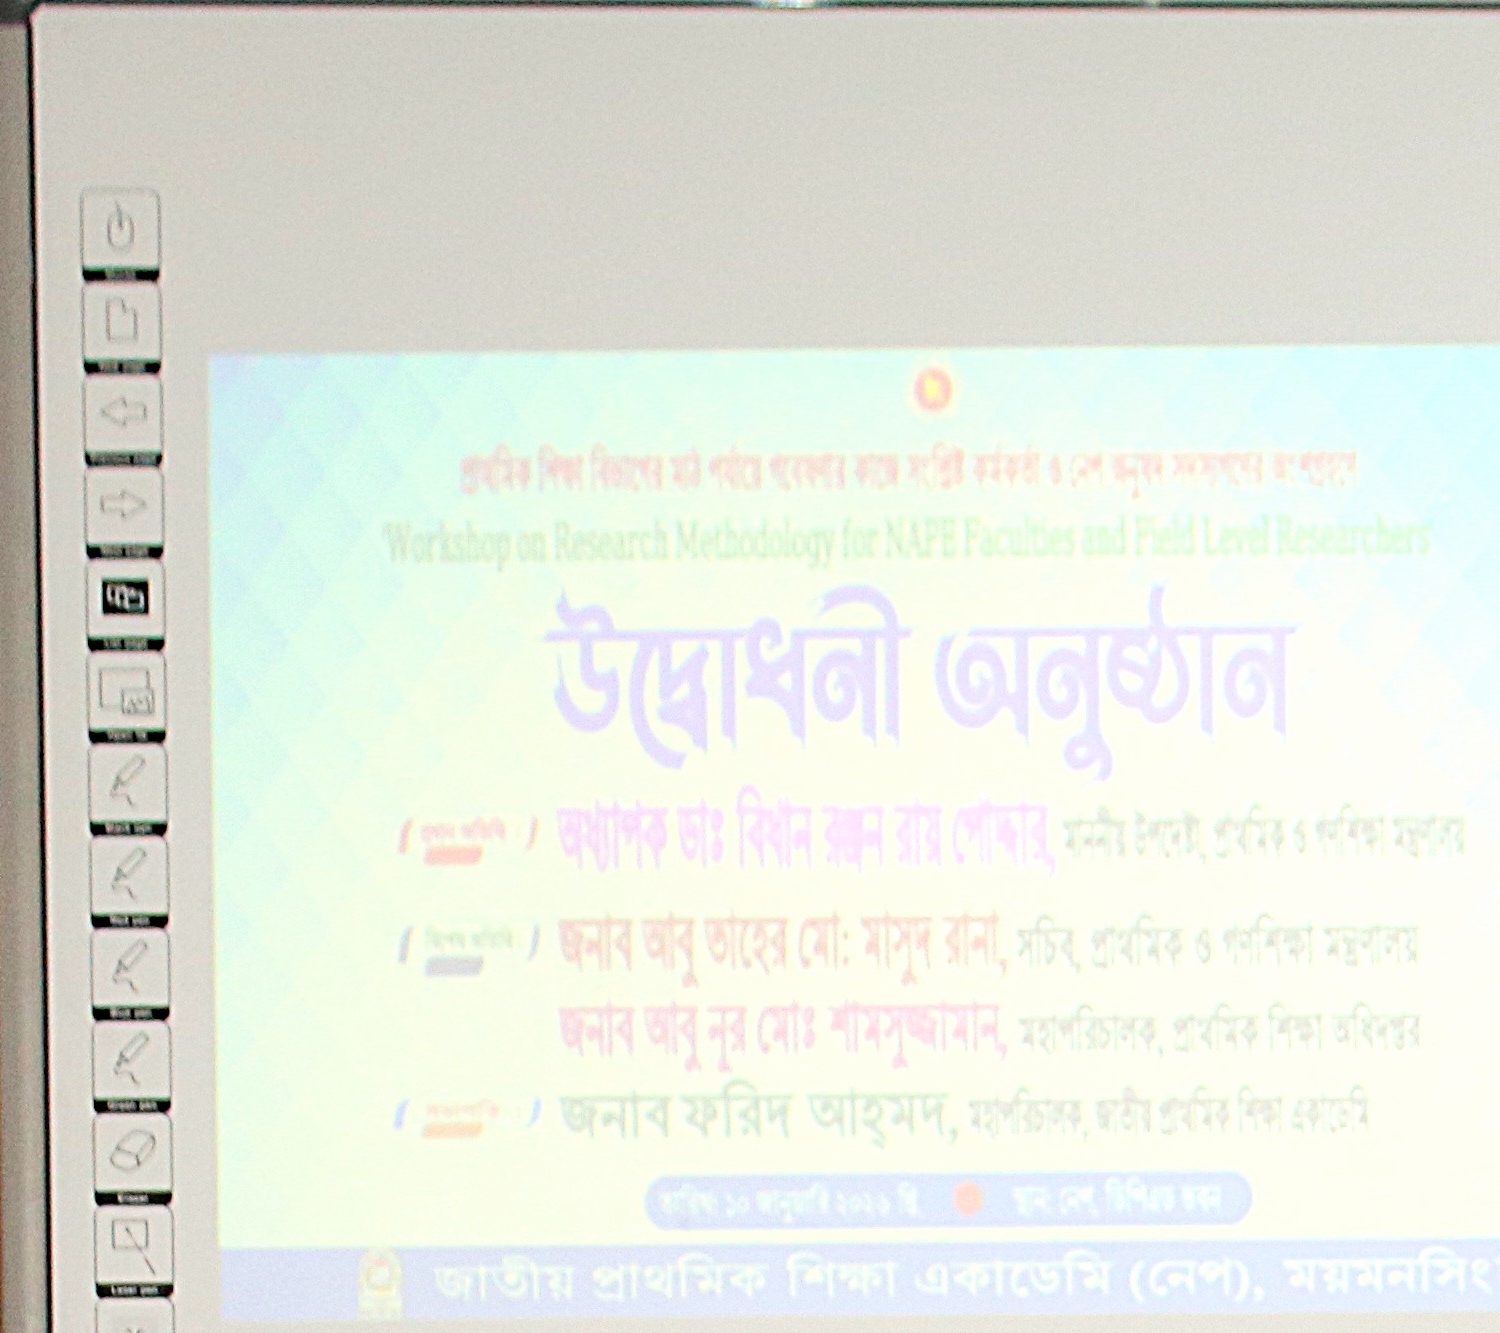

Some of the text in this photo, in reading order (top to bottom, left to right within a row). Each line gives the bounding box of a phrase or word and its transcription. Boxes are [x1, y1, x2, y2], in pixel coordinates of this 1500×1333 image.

[517, 530, 550, 563] on
[554, 516, 671, 562] Research
[674, 516, 836, 571] Methodology
[841, 515, 881, 560] for
[884, 515, 960, 560] NAPE
[963, 514, 1078, 560] Faculties
[1082, 513, 1129, 559] and
[1134, 512, 1196, 558] Field
[1201, 511, 1269, 558] Level
[545, 582, 1299, 782] উদ্বোধনী অনুষ্ঠান
[556, 798, 670, 873] অধ্যাপক
[735, 784, 813, 867] বিধান
[1292, 818, 1309, 855] ও
[557, 912, 635, 971] জনাব
[642, 912, 700, 988] আবু
[704, 912, 790, 974] তাহের
[860, 912, 934, 986] মাসুদ
[1091, 911, 1186, 970] প্রাথমিক
[1194, 927, 1214, 965] ও
[557, 1002, 635, 1057] জনাব
[643, 1002, 702, 1073] আবু
[1171, 1002, 1261, 1053] প্রাথমিক
[1267, 1000, 1324, 1050] শিক্ষা
[558, 1089, 673, 1140] জনাব
[678, 1078, 795, 1140] ফরিদ
[433, 1254, 575, 1303] জাতীয়
[589, 1248, 769, 1306] প্রাথমিক
[785, 1248, 896, 1300] শিক্ষা
[913, 1247, 1112, 1300] একাডেমি
